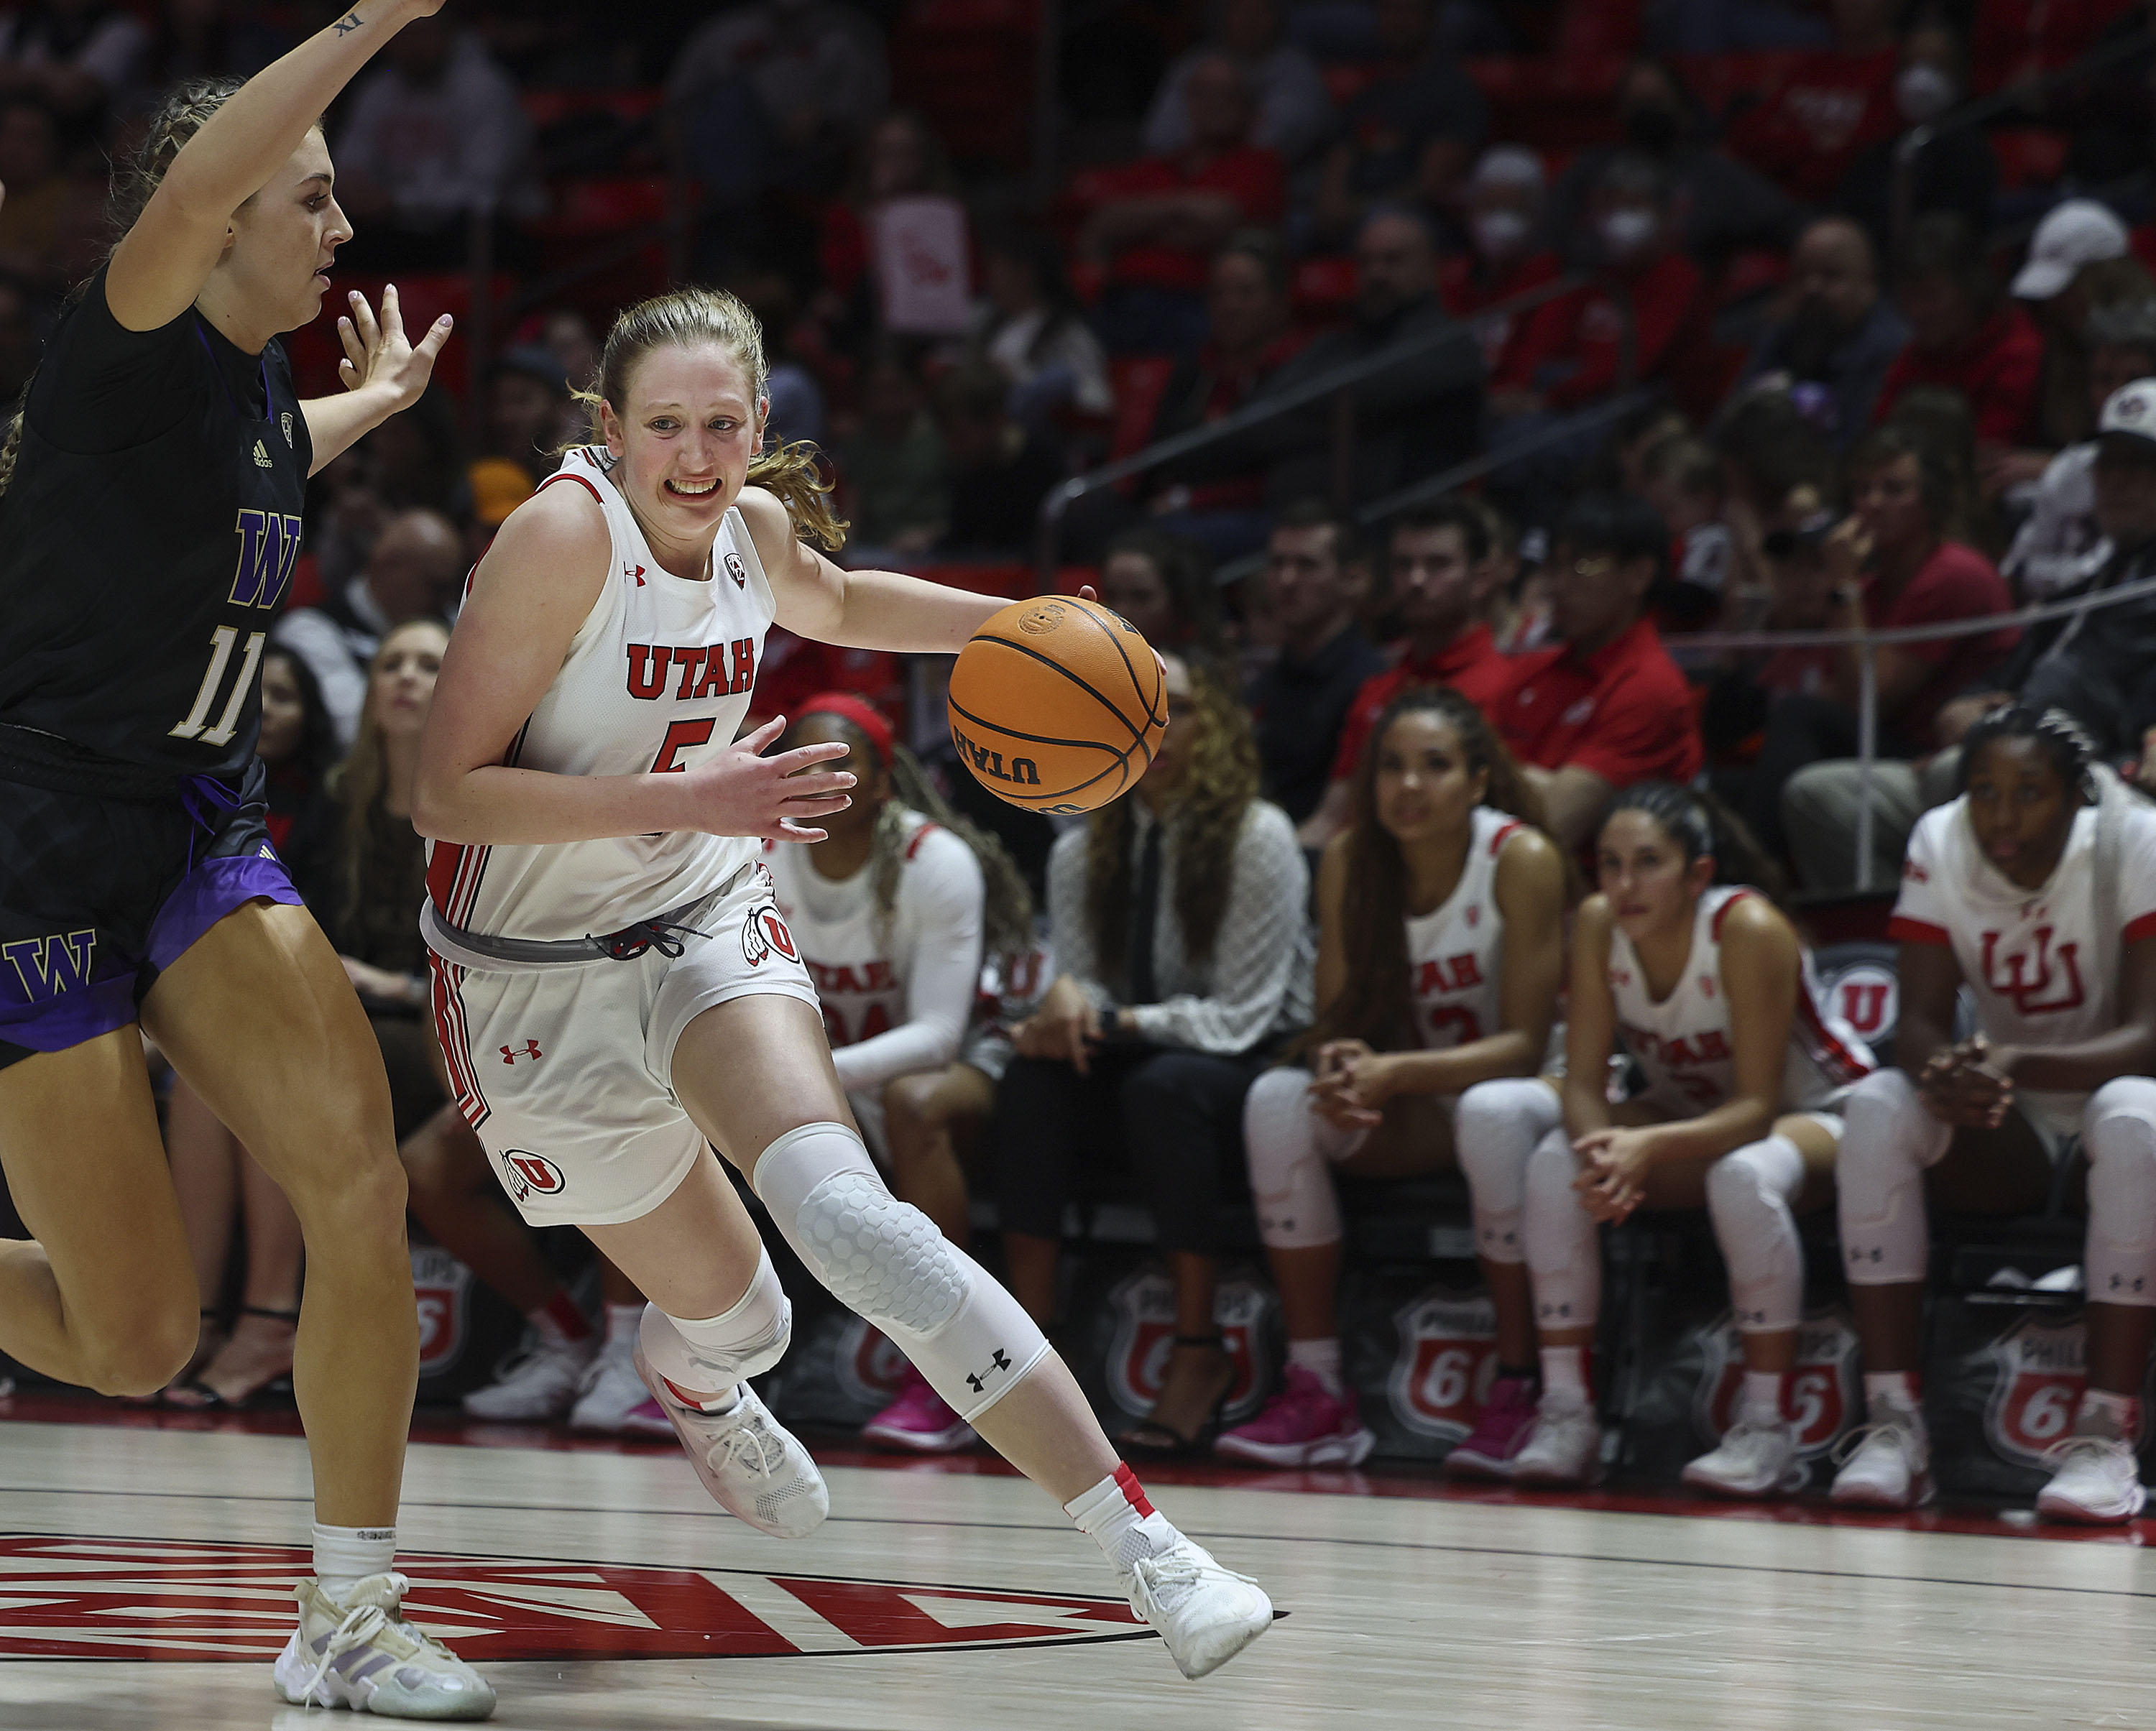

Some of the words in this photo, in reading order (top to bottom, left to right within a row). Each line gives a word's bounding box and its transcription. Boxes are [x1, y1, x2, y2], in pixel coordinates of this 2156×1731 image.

[333, 12, 364, 37] XI
[227, 508, 302, 610] W
[167, 624, 266, 740] 11
[627, 637, 755, 701] UTAH
[953, 725, 1041, 785] UTAH
[763, 915, 795, 958] U
[1, 928, 97, 1004] W
[1843, 985, 1888, 1033] U
[510, 1157, 556, 1188] U
[2020, 1384, 2076, 1439] 6
